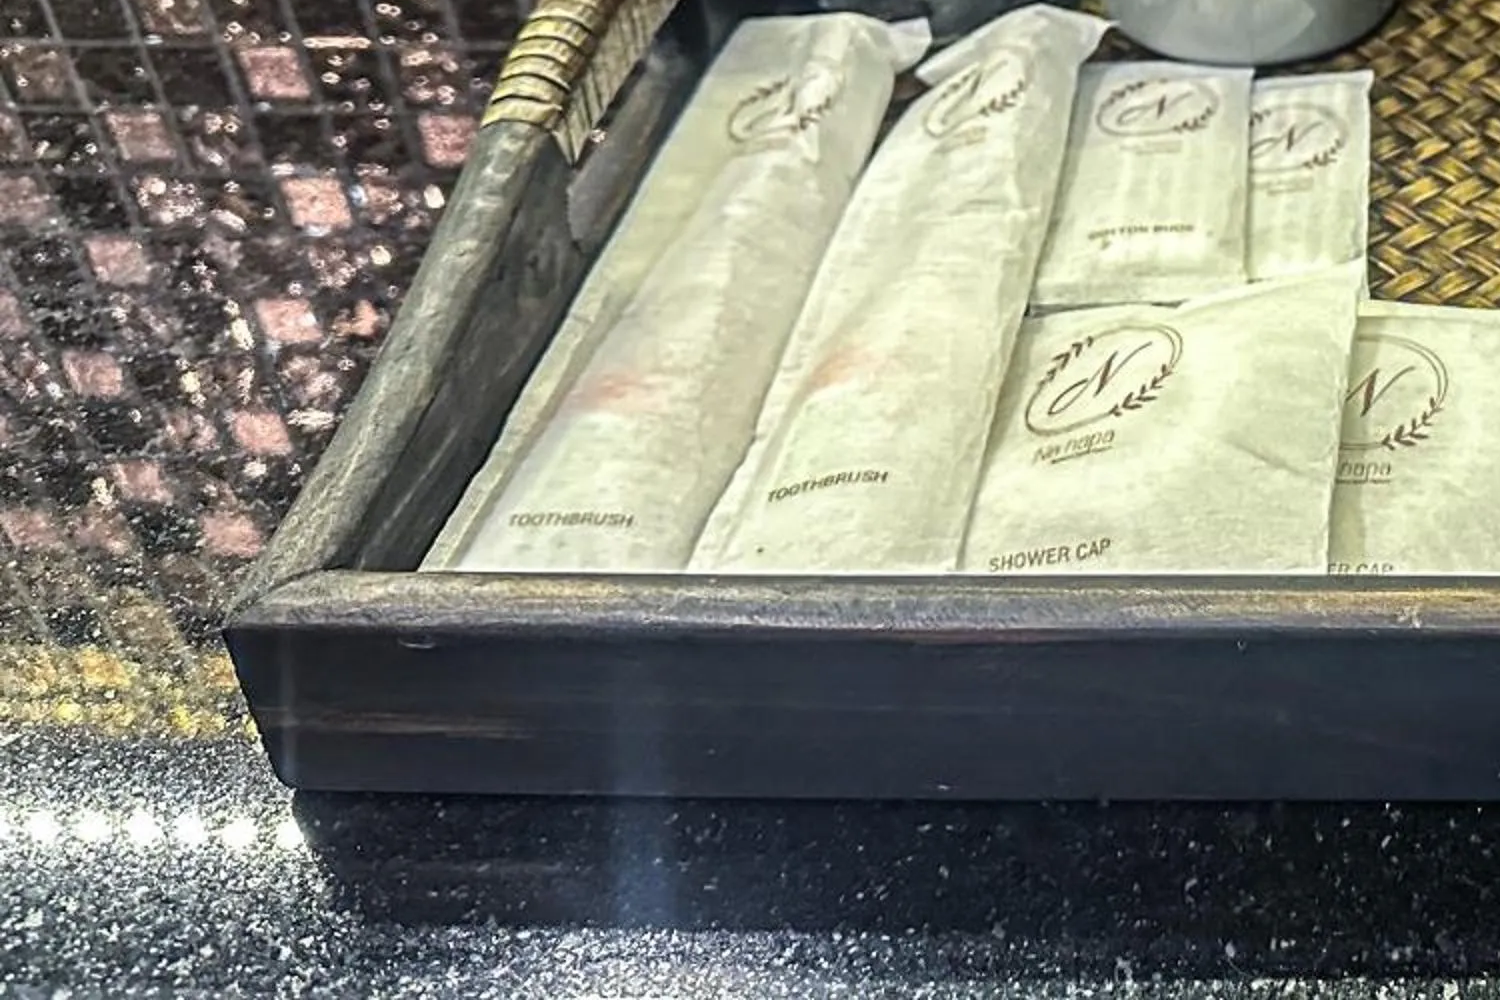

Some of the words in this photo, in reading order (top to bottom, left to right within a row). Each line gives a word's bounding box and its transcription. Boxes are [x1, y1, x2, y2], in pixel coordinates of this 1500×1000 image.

[766, 470, 889, 502] TOOTHBRUSH
[509, 511, 634, 529] TOOTHBRUSH
[988, 545, 1070, 572] SHOWER
[1075, 537, 1112, 561] CAP
